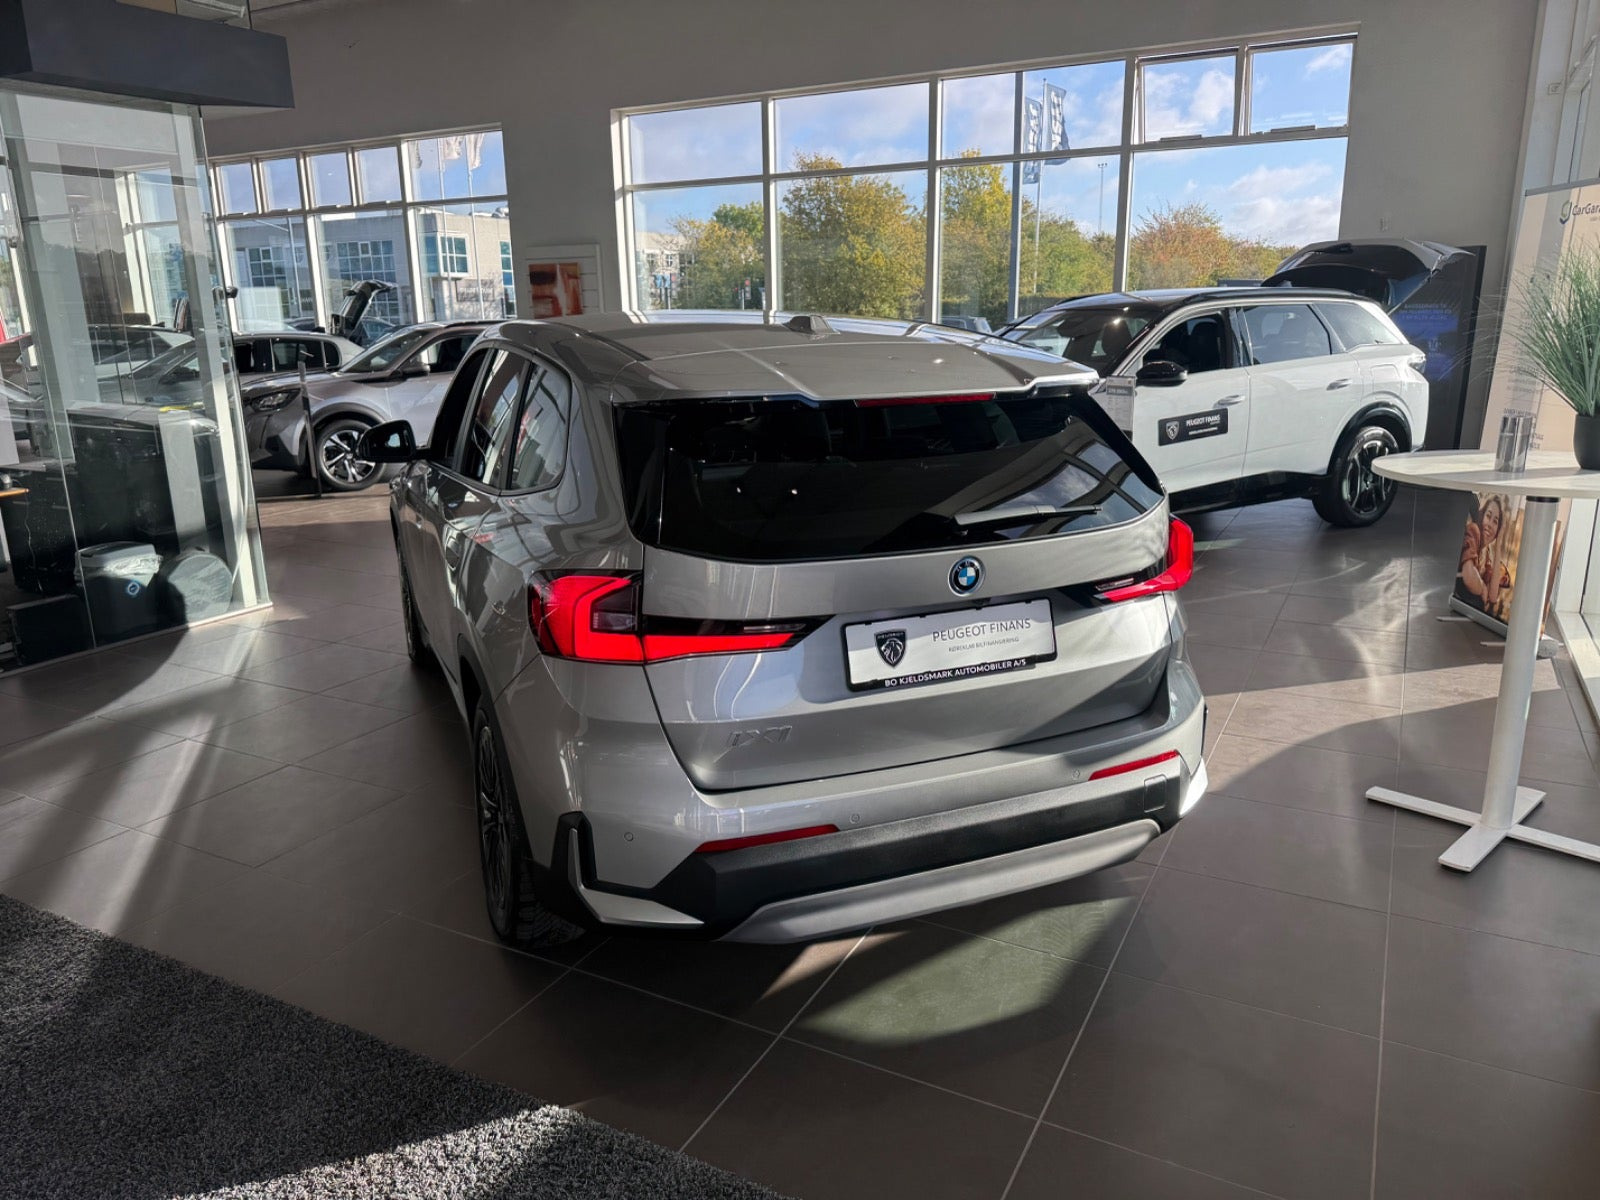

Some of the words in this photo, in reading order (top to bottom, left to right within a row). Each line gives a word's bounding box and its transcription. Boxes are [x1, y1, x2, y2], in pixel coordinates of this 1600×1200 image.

[932, 624, 987, 643] PEUGEOT
[989, 618, 1031, 634] FINANS
[884, 678, 898, 688] BO
[899, 669, 954, 686] KJELDSMARK
[954, 660, 1012, 677] AUTOMOBILER
[1013, 658, 1027, 668] A/S
